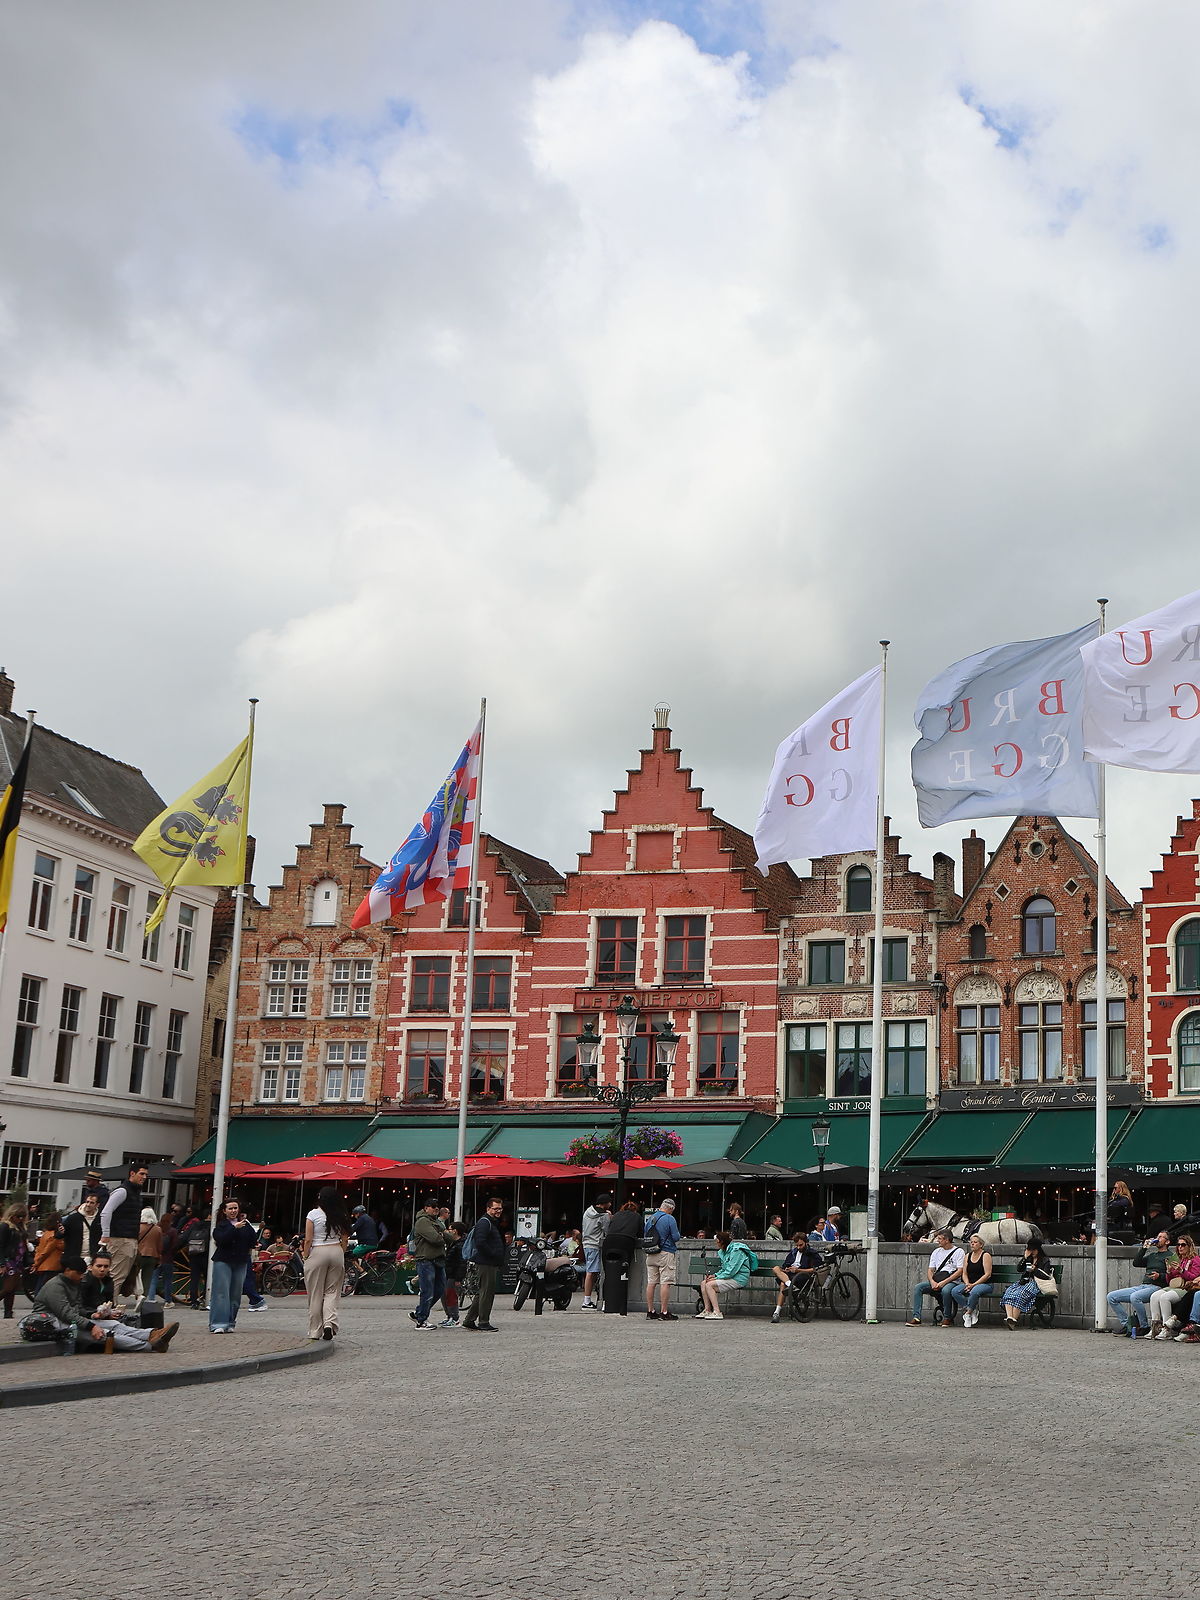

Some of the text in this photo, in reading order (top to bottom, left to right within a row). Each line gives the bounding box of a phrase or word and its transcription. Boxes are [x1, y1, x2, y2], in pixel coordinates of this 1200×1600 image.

[580, 991, 718, 1009] LE PNIER D'OR
[1020, 1090, 1057, 1107] Central
[828, 1102, 851, 1111] SINT
[1136, 1164, 1158, 1174] Pizza
[1168, 1164, 1181, 1173] LA
